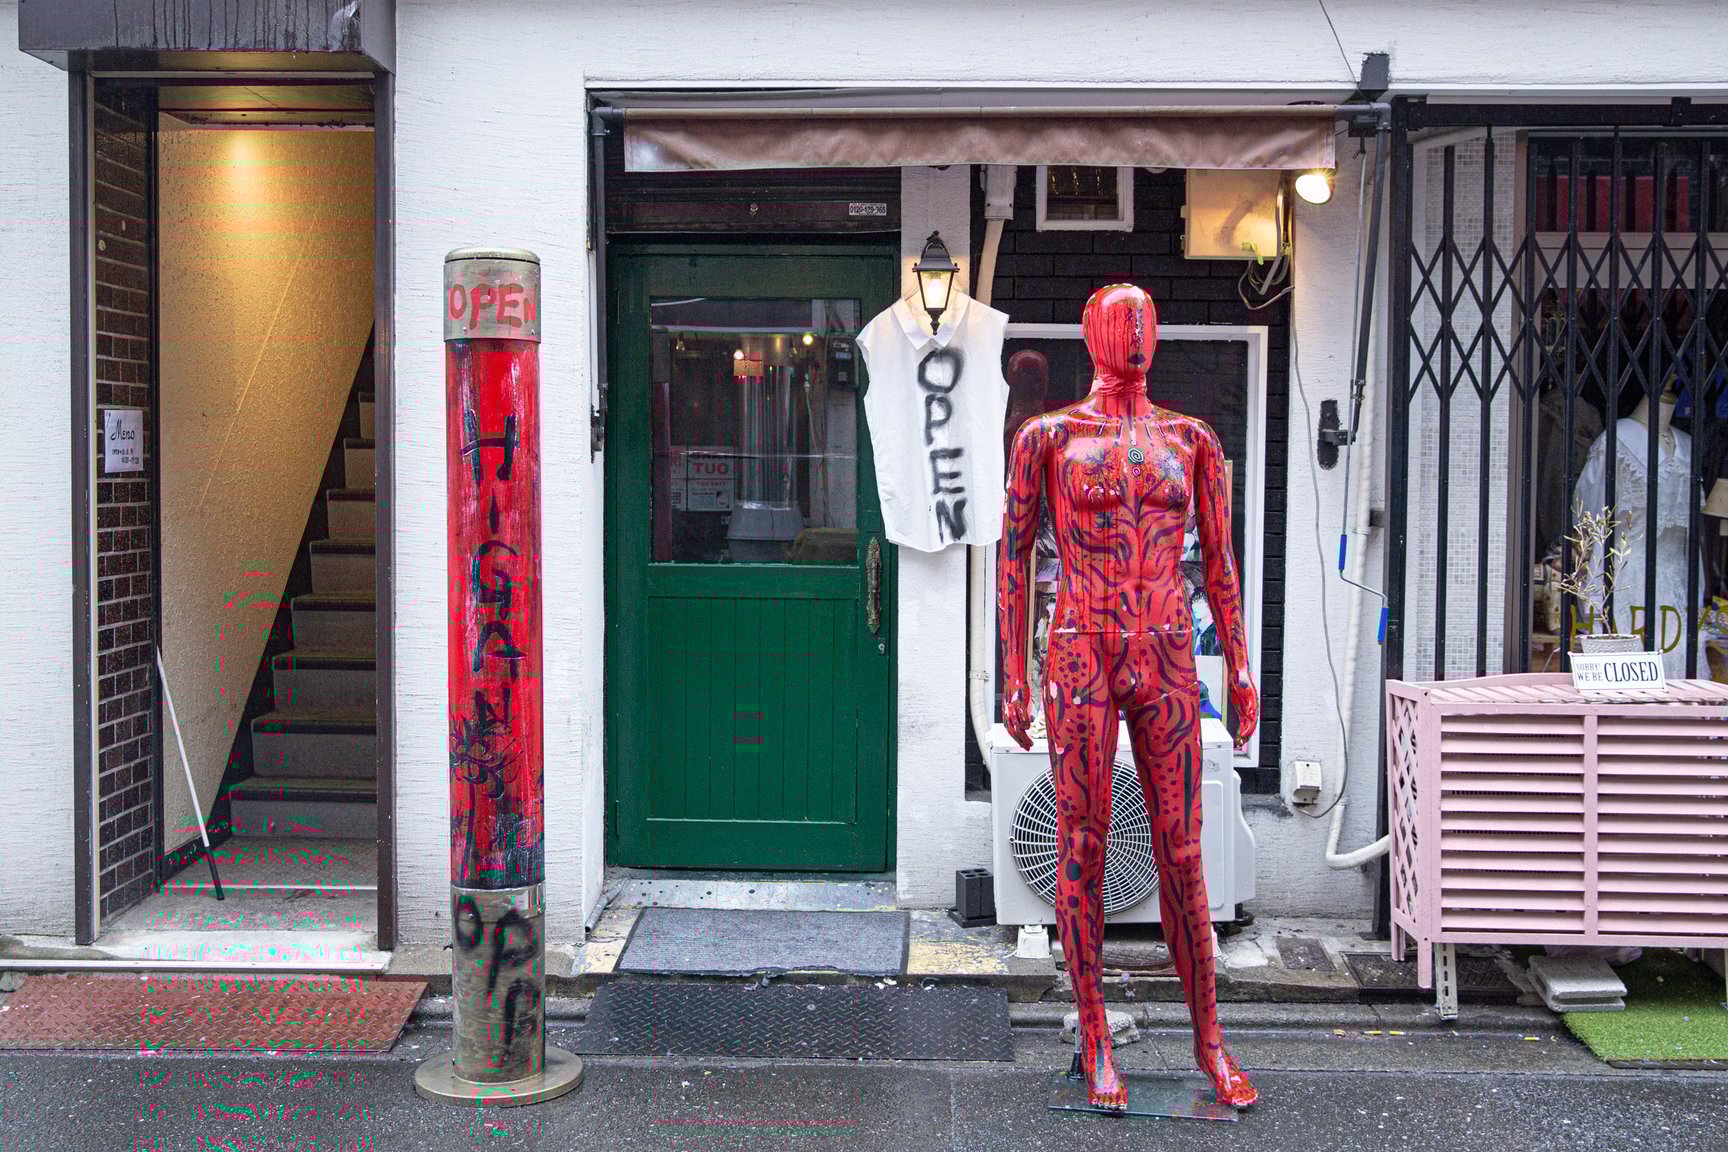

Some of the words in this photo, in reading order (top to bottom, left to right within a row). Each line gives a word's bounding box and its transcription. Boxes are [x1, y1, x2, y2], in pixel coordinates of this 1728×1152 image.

[450, 283, 538, 330] OPEN
[917, 347, 968, 544] OPEN
[1604, 661, 1659, 683] CLOSED
